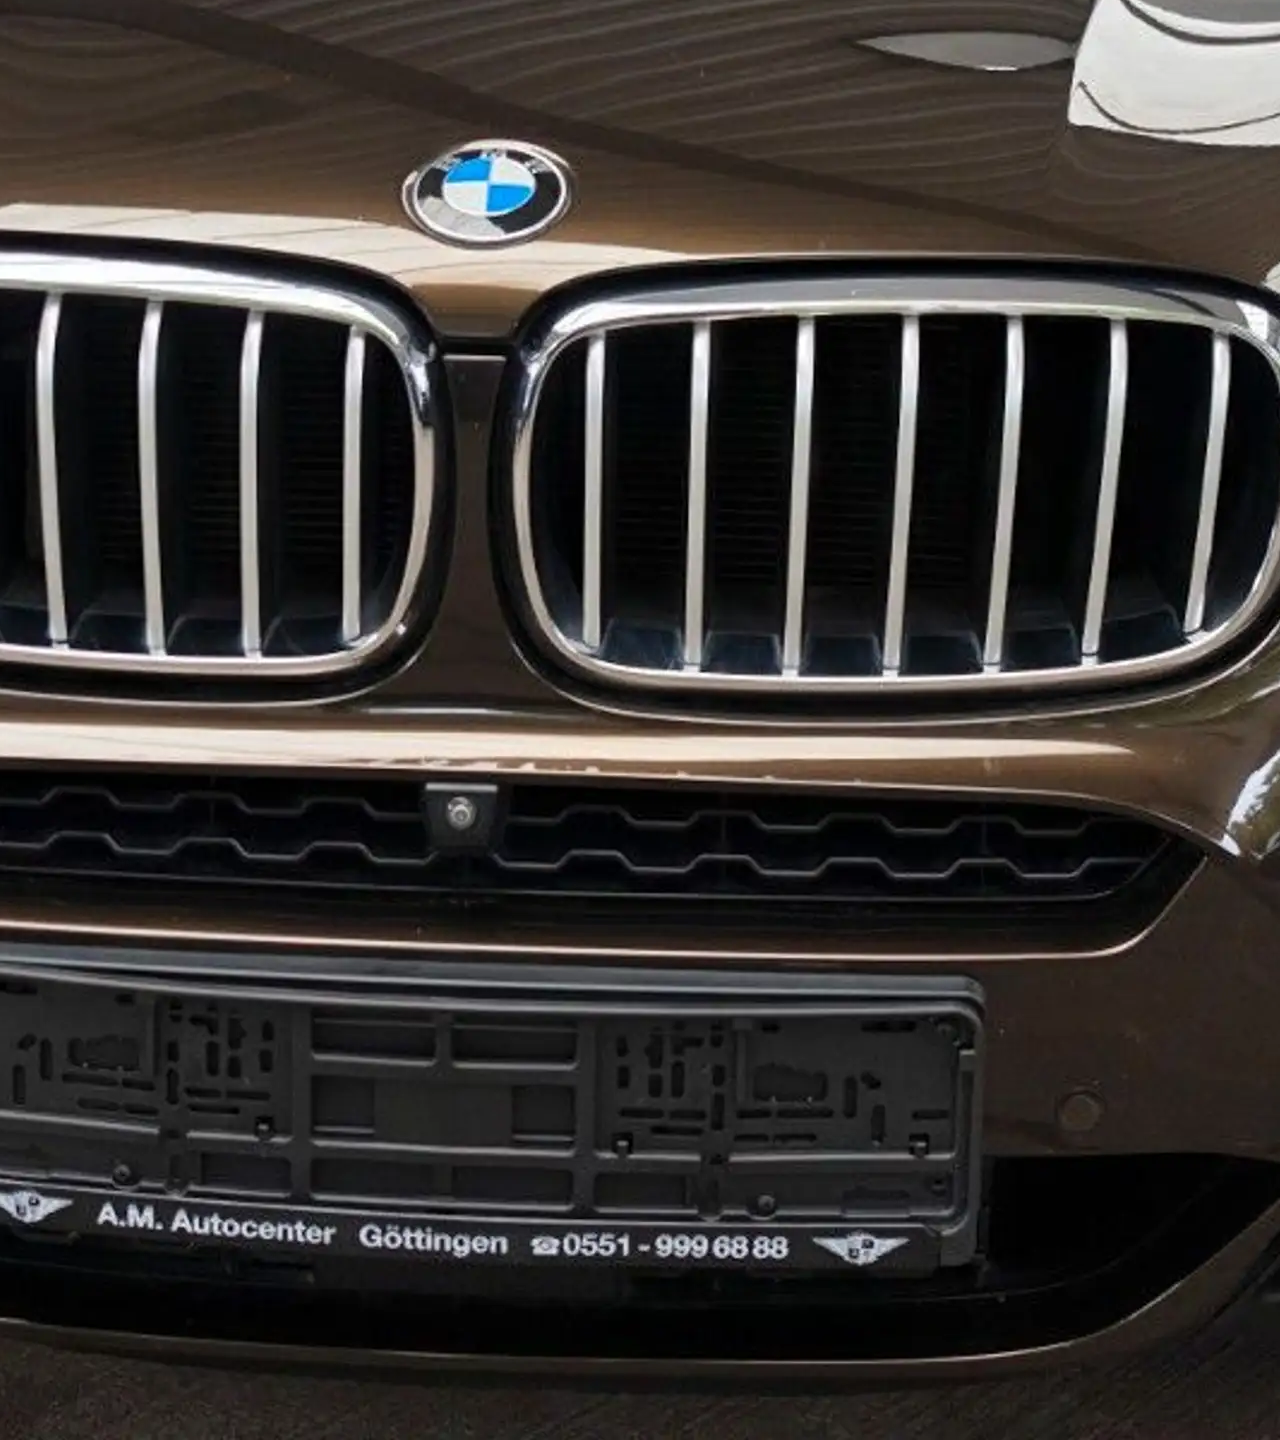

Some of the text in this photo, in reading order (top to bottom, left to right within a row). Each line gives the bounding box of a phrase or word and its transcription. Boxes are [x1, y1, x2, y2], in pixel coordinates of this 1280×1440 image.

[97, 1203, 163, 1231] A.M.
[171, 1209, 336, 1245] Autocenter
[359, 1223, 508, 1258] Göttingen
